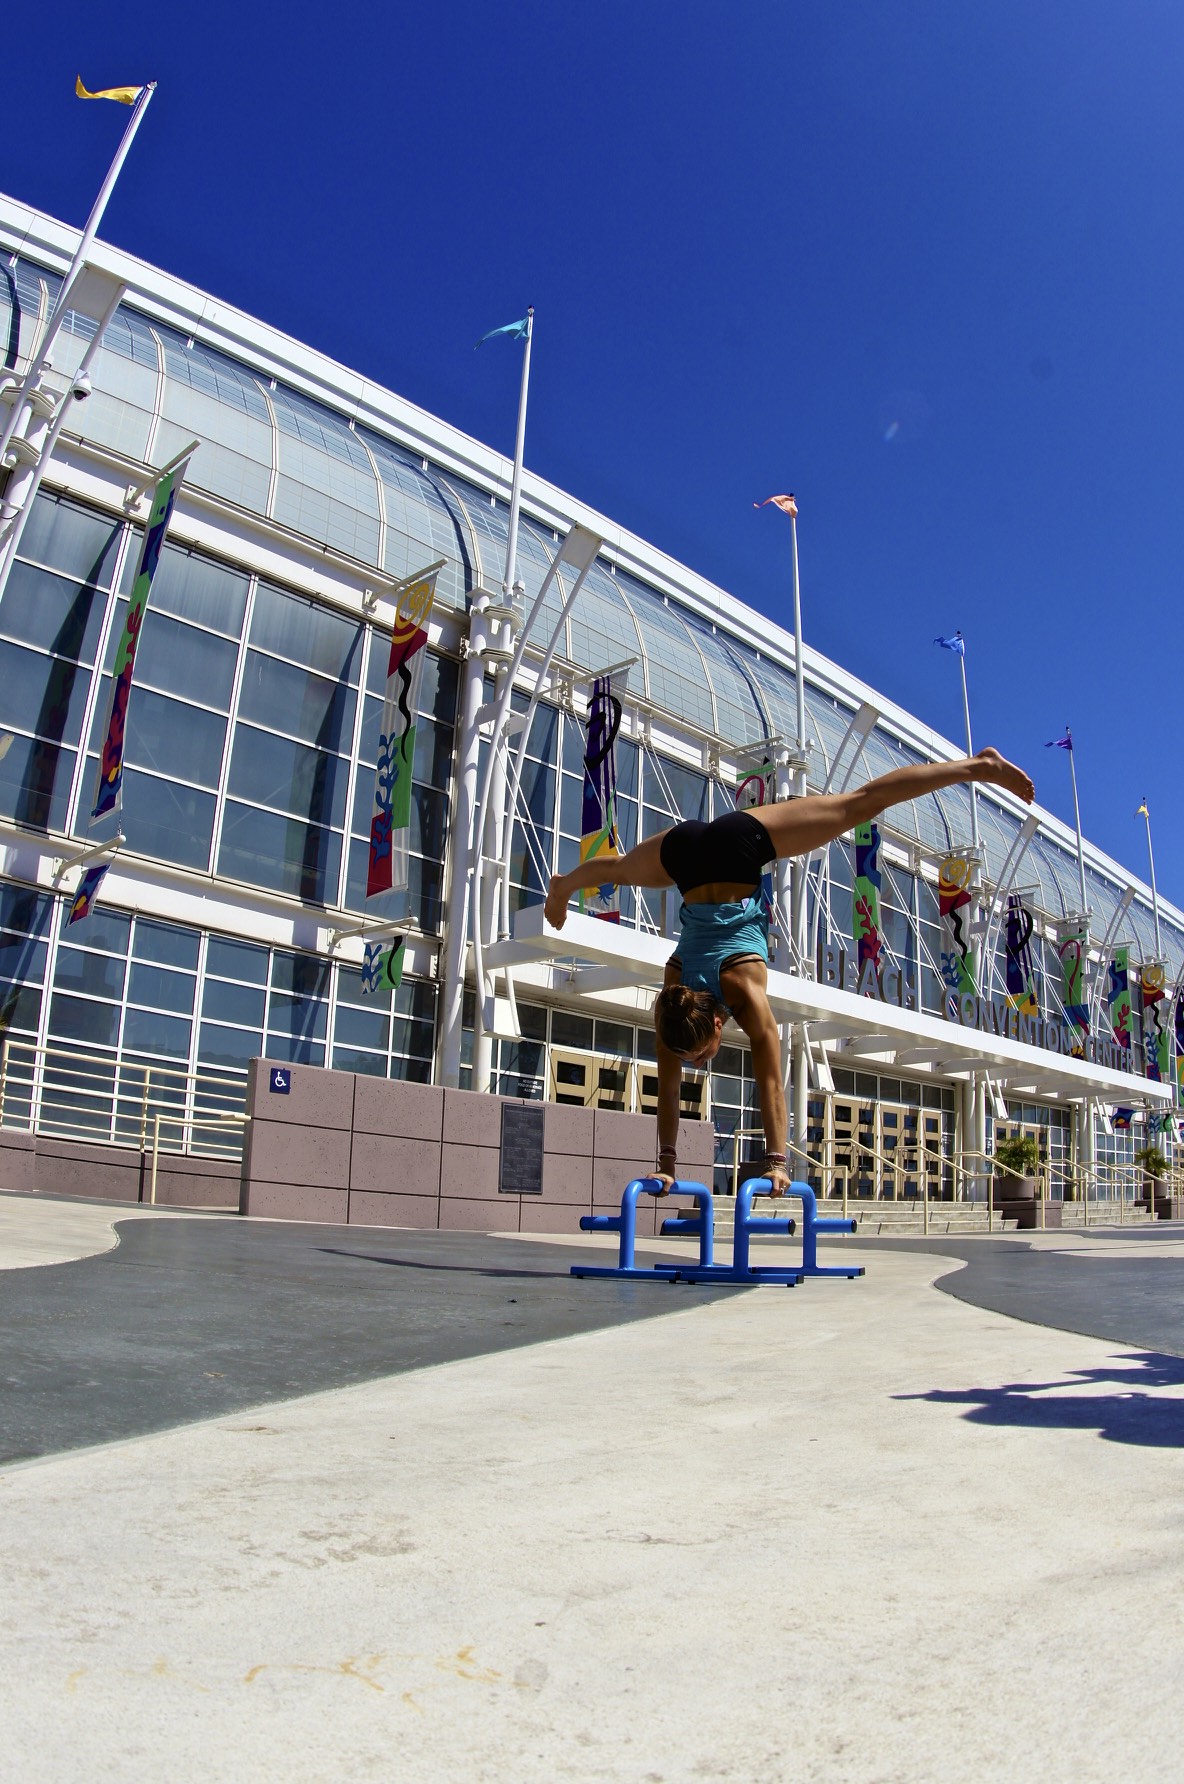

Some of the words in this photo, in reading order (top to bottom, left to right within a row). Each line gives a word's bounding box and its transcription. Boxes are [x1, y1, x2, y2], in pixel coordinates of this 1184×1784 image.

[817, 943, 918, 1012] BEACH
[941, 986, 1072, 1055] CONVENTION
[1083, 1035, 1134, 1073] CENTER
